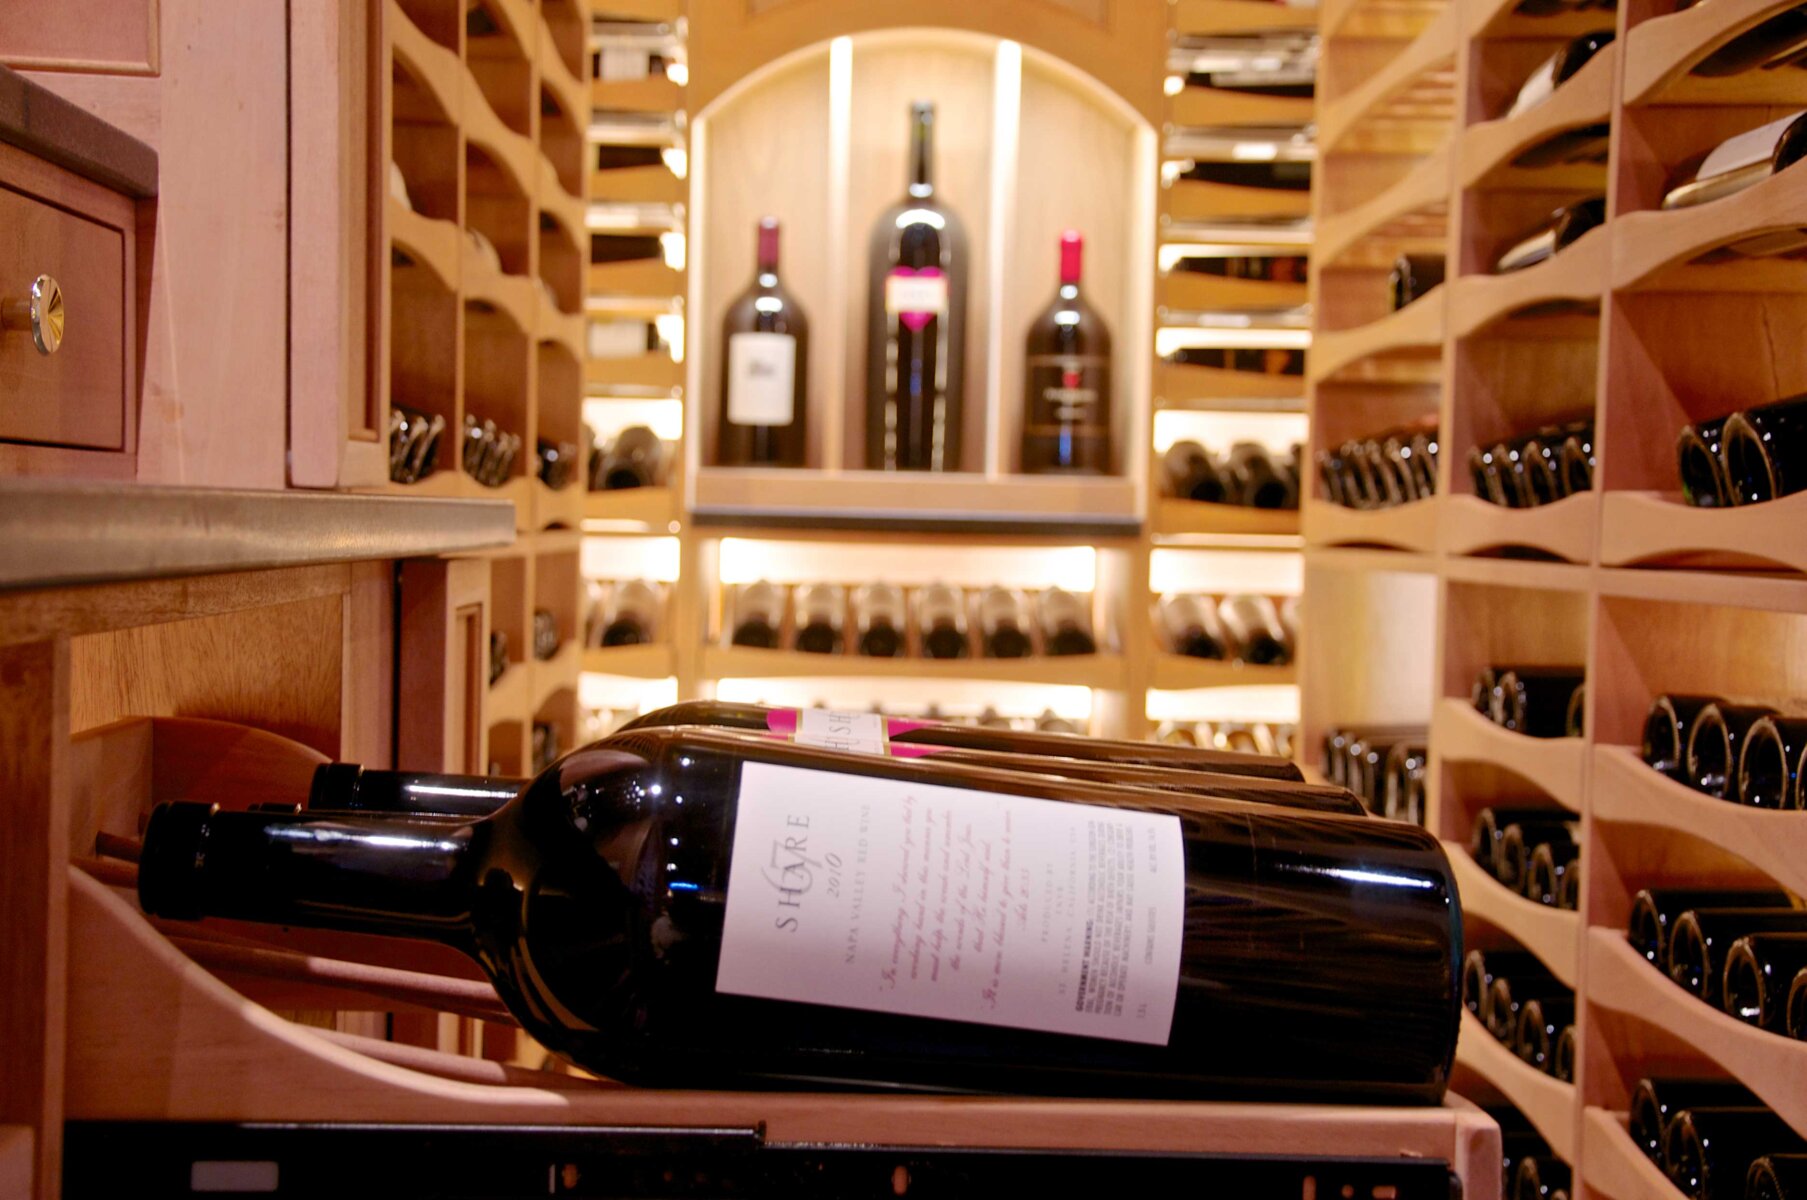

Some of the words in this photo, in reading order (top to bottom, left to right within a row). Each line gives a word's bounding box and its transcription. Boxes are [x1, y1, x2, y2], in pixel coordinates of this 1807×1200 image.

[859, 804, 870, 833] WINE
[761, 840, 821, 895] 67
[775, 815, 809, 932] SHARE
[856, 838, 867, 863] RED
[824, 852, 842, 898] 2010
[850, 870, 865, 920] VALLEY
[844, 927, 858, 964] NAPA
[1074, 960, 1089, 1012] GOVERNMENT
